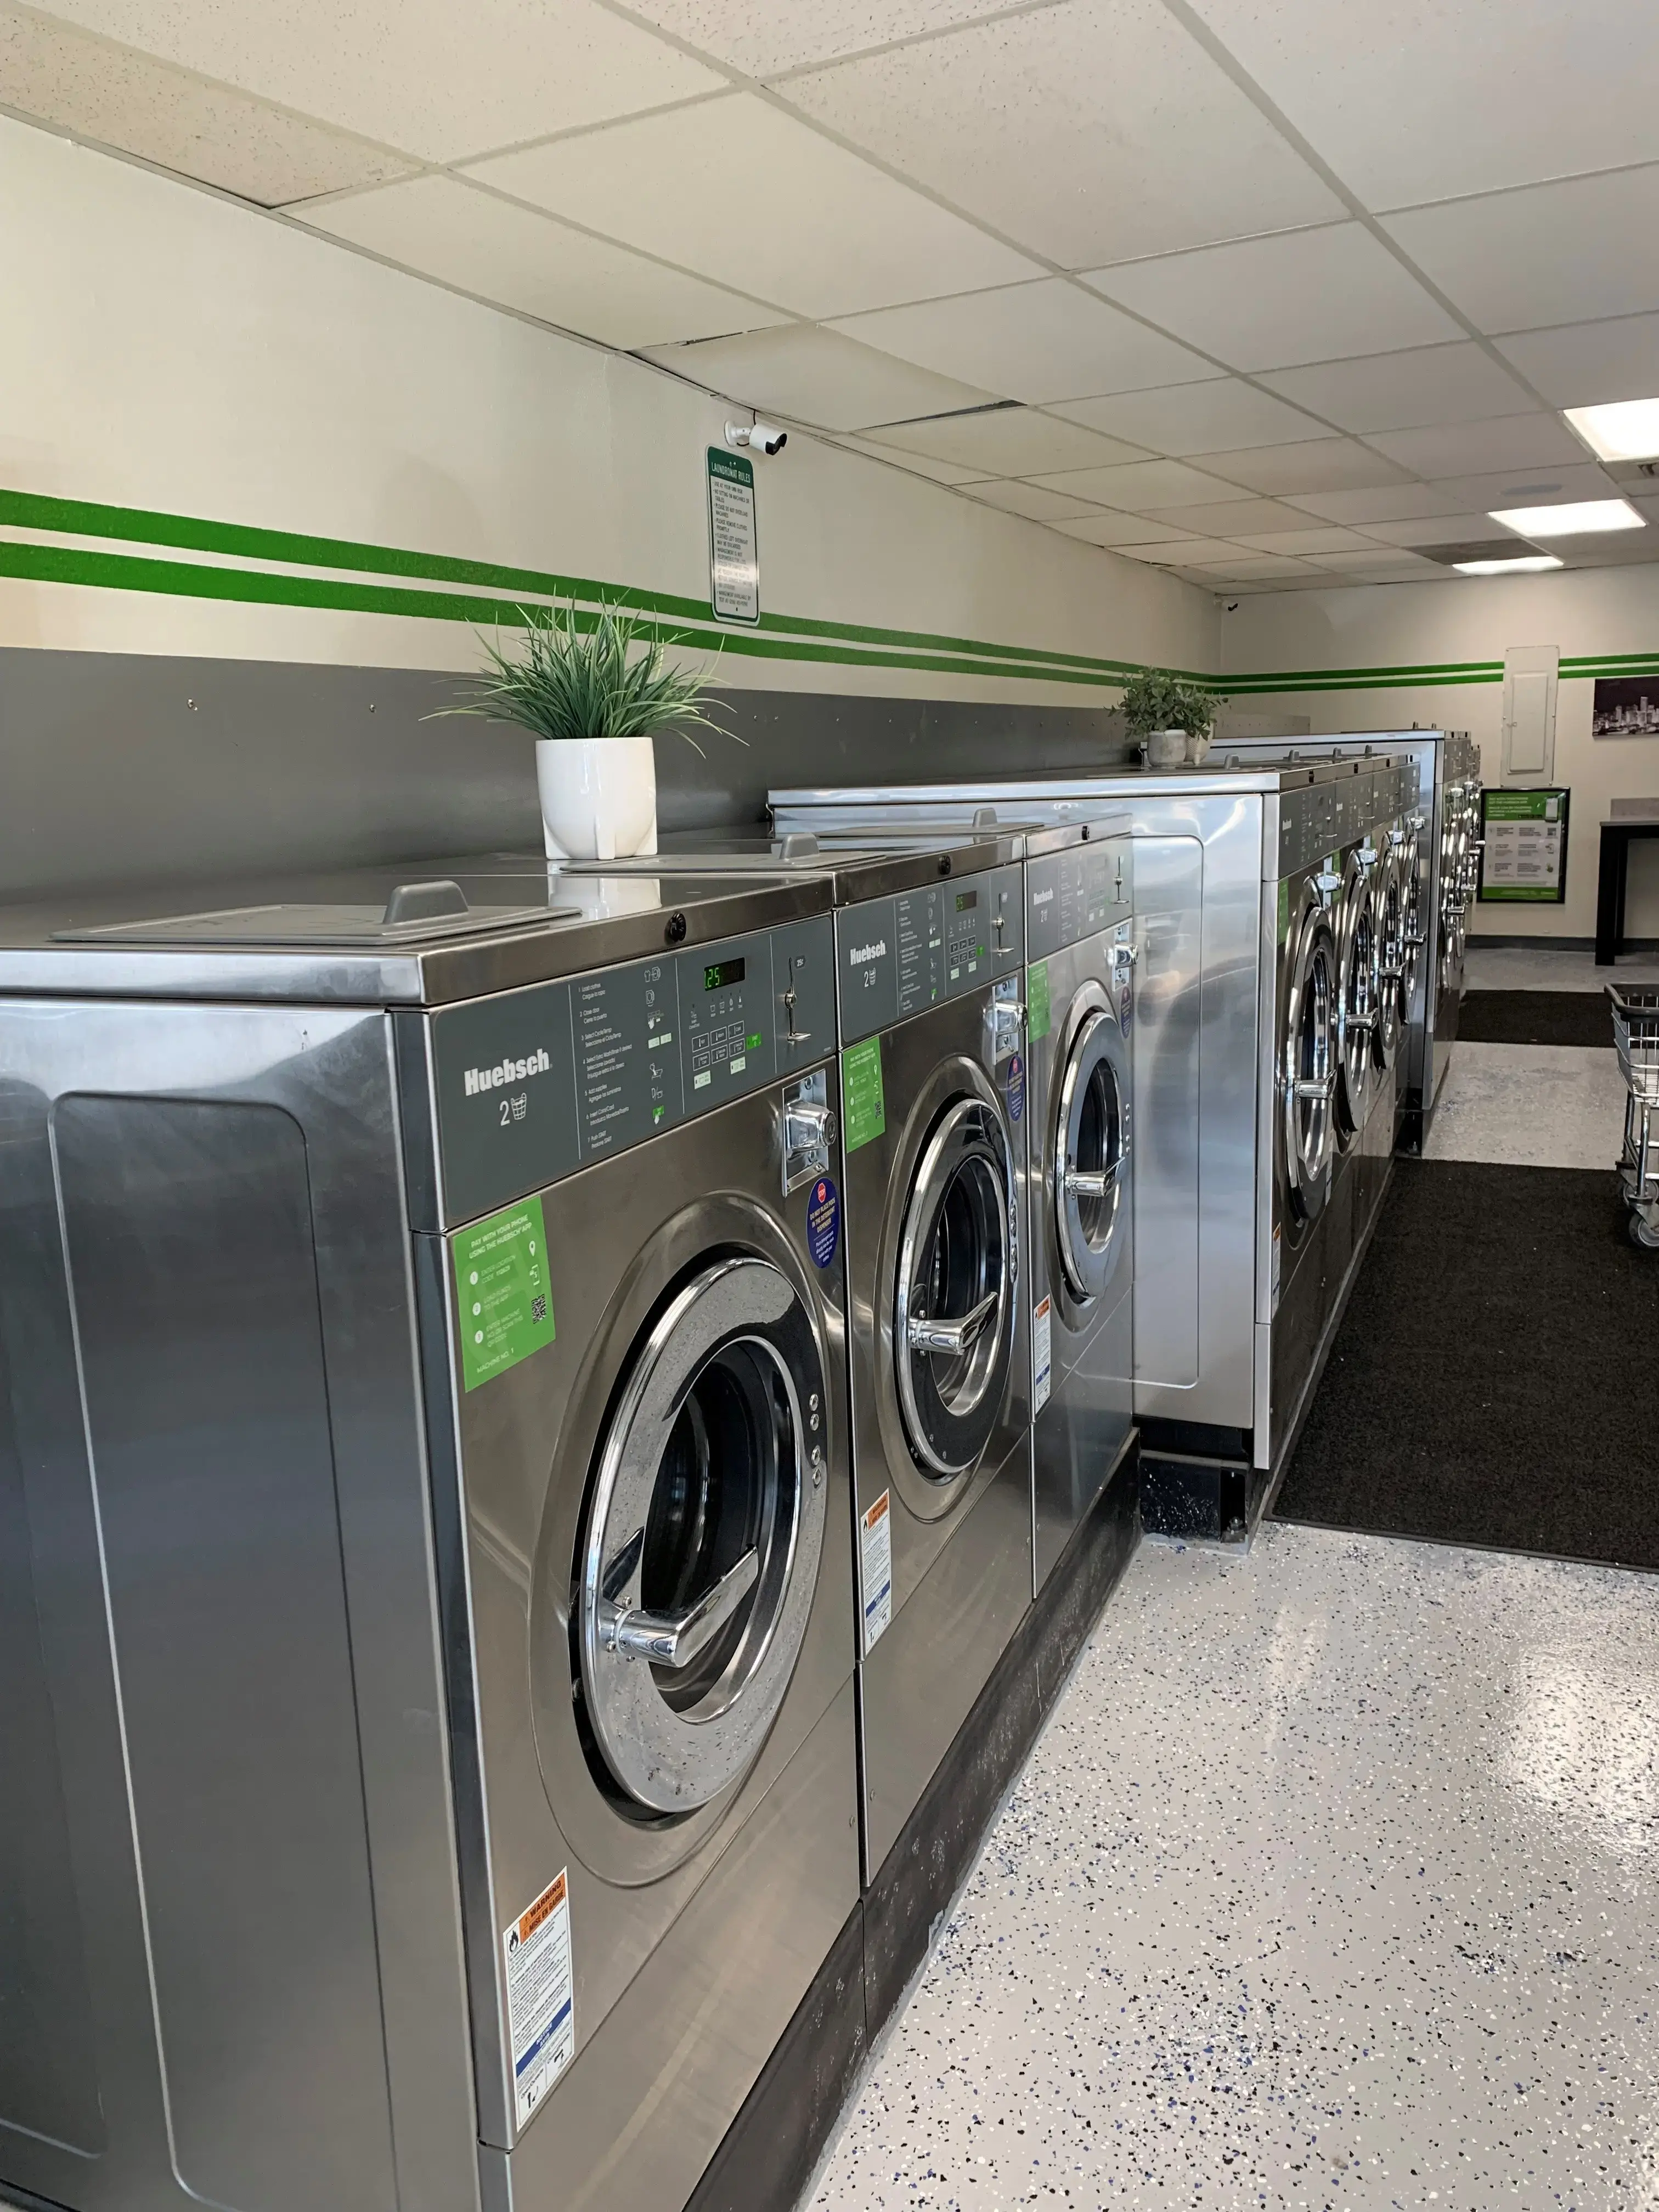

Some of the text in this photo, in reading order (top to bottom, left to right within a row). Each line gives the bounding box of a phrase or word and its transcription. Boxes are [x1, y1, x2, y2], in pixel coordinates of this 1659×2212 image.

[711, 461, 750, 483] LAUNDROMAT RULES
[850, 940, 885, 966] Huebsch
[864, 971, 869, 988] 2
[464, 1048, 550, 1096] Huebsch
[499, 1100, 510, 1126] 2
[810, 1212, 814, 1220] DO
[469, 1245, 486, 1259] USING
[486, 1239, 496, 1250] THE
[521, 1221, 532, 1232] APP
[471, 1214, 528, 1248] PAY WITH YOUR PHONE
[476, 1355, 500, 1374] MACHINE
[529, 1889, 563, 1932] MISE EN GARDE
[531, 1880, 561, 1918] WARNING
[537, 2021, 552, 2045] NOTICE
